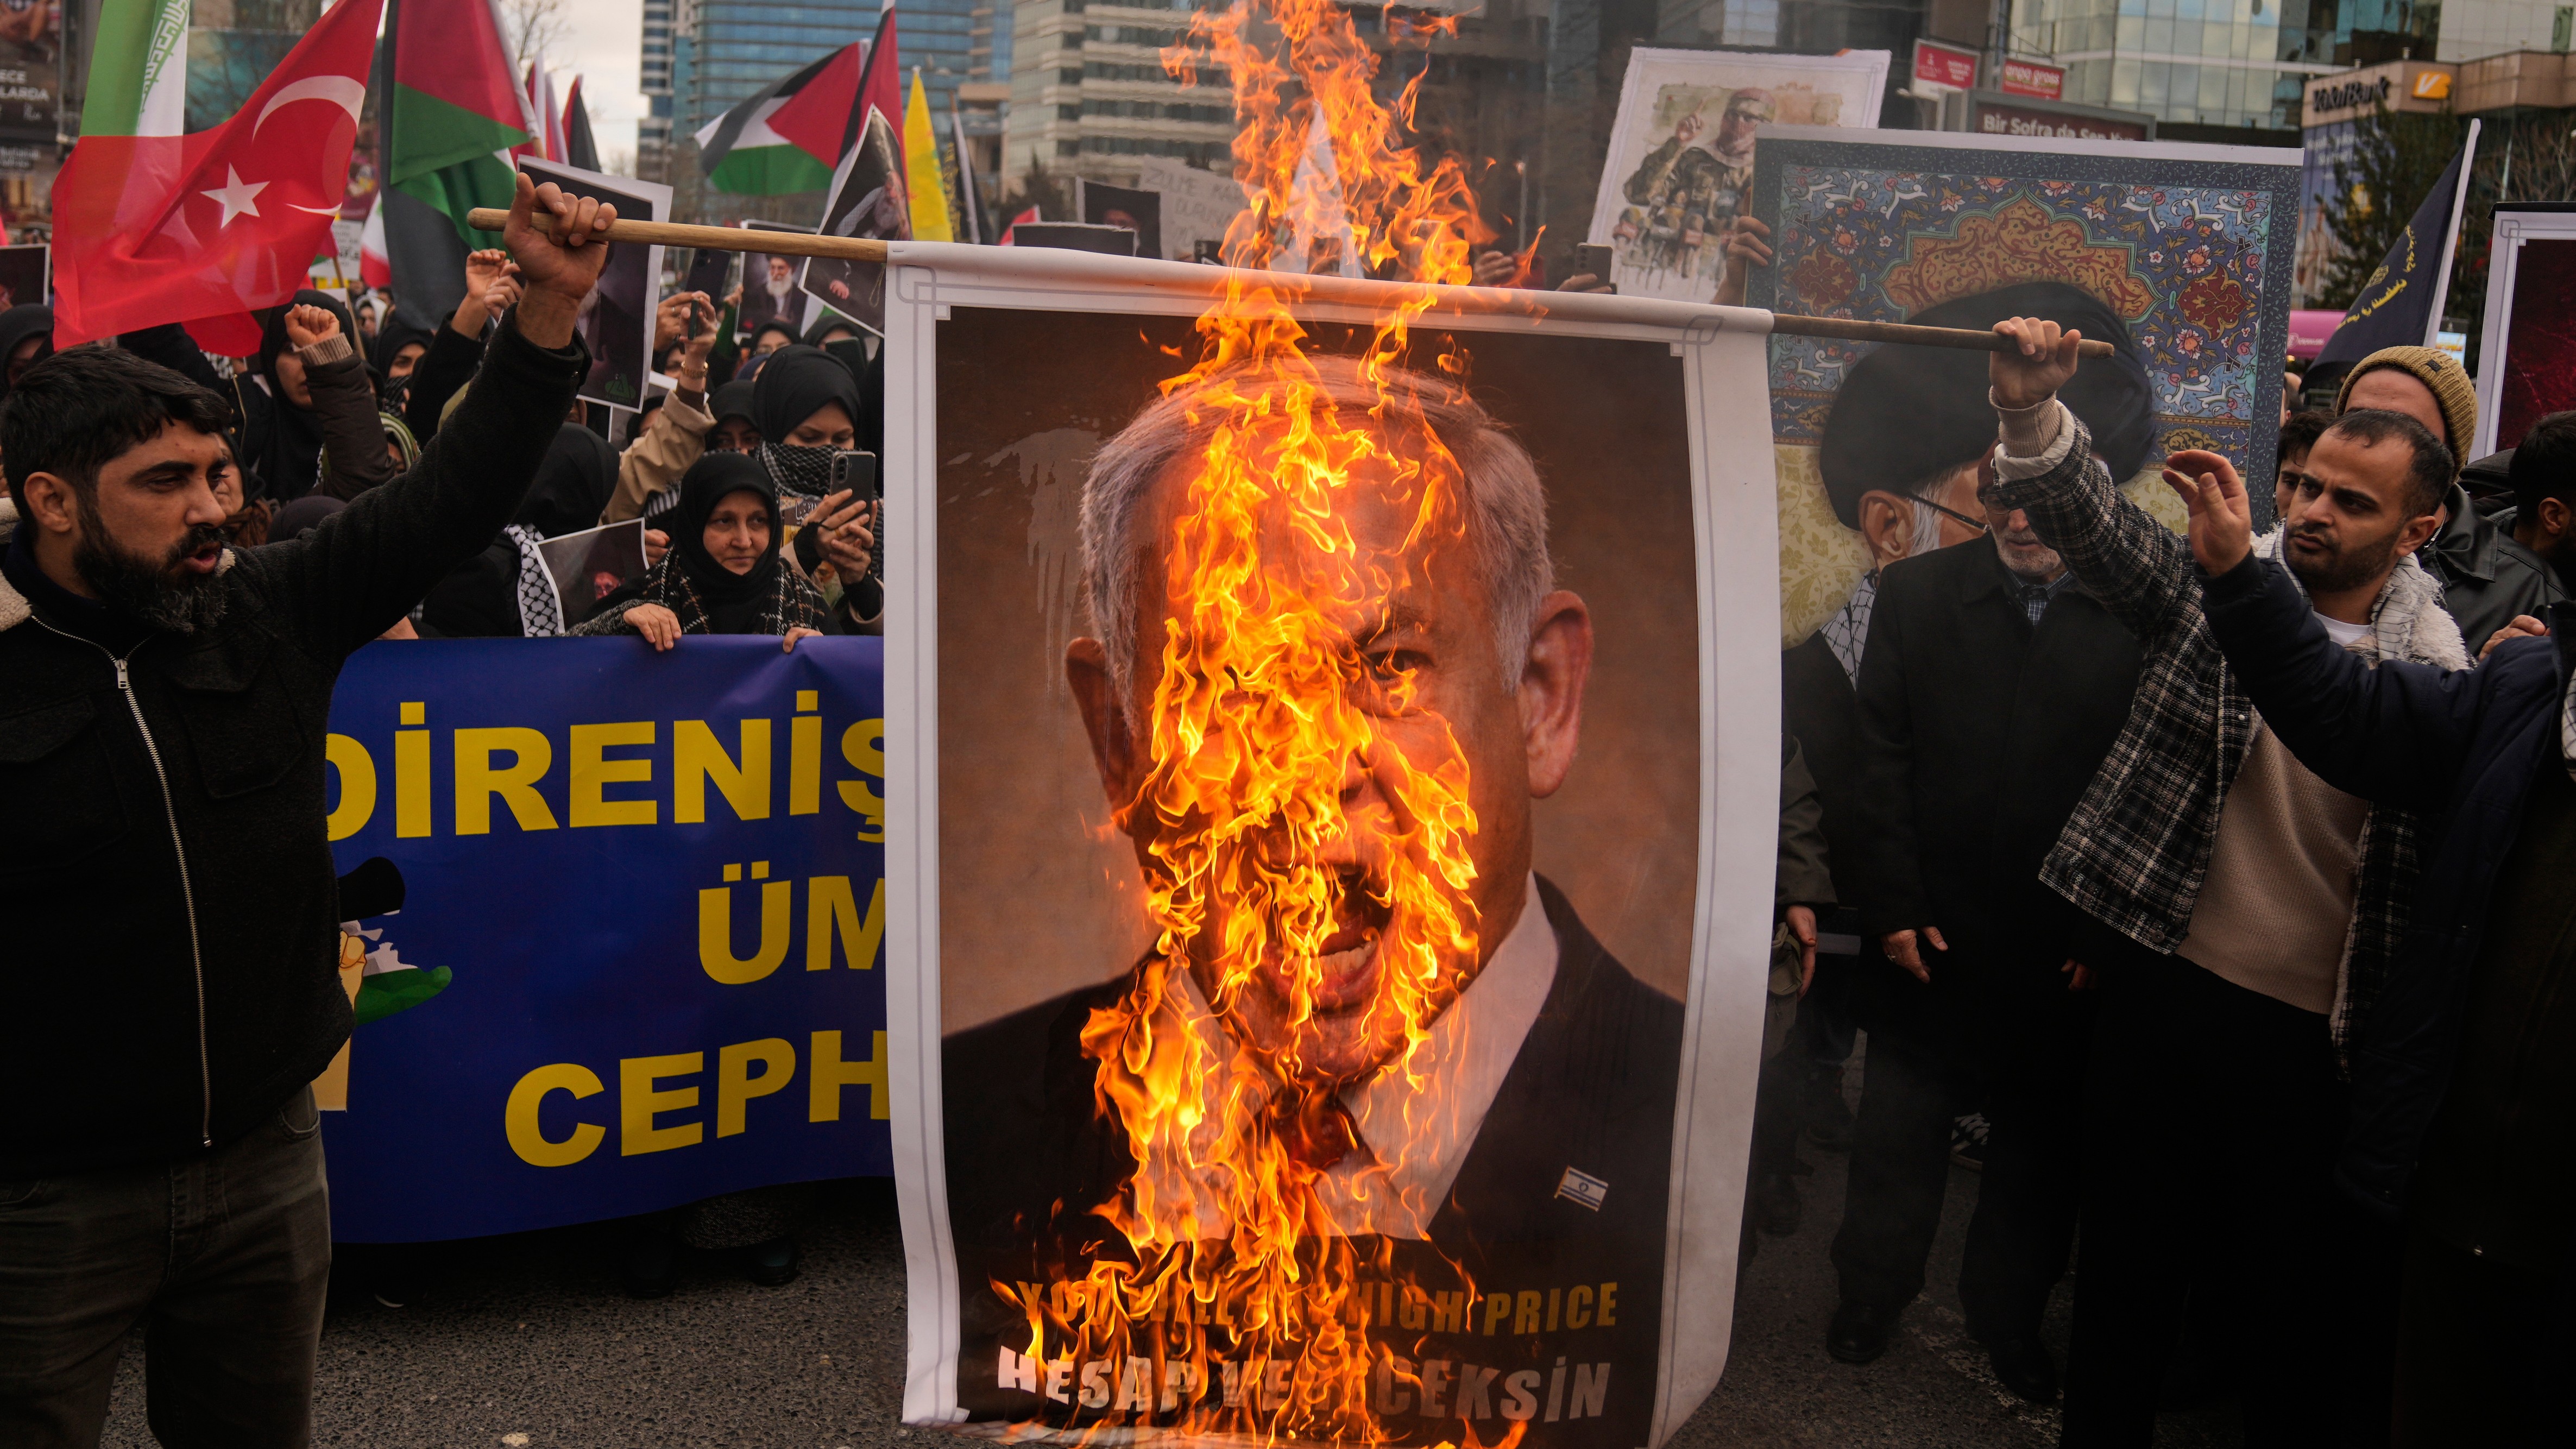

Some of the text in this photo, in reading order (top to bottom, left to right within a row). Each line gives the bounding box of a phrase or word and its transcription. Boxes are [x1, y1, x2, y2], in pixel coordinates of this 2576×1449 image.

[1983, 112, 2008, 133] Bir
[2010, 116, 2053, 137] Sofra
[2056, 122, 2076, 138] da
[699, 861, 885, 984] ÜM
[505, 1030, 890, 1167] CEPH
[1016, 1280, 1111, 1325] YOU
[1128, 1280, 1234, 1325] WILL
[1345, 1282, 1464, 1334] HIGH
[1483, 1281, 1617, 1336] PRICE
[998, 1345, 1611, 1422] HESAP VERCEKSİN
